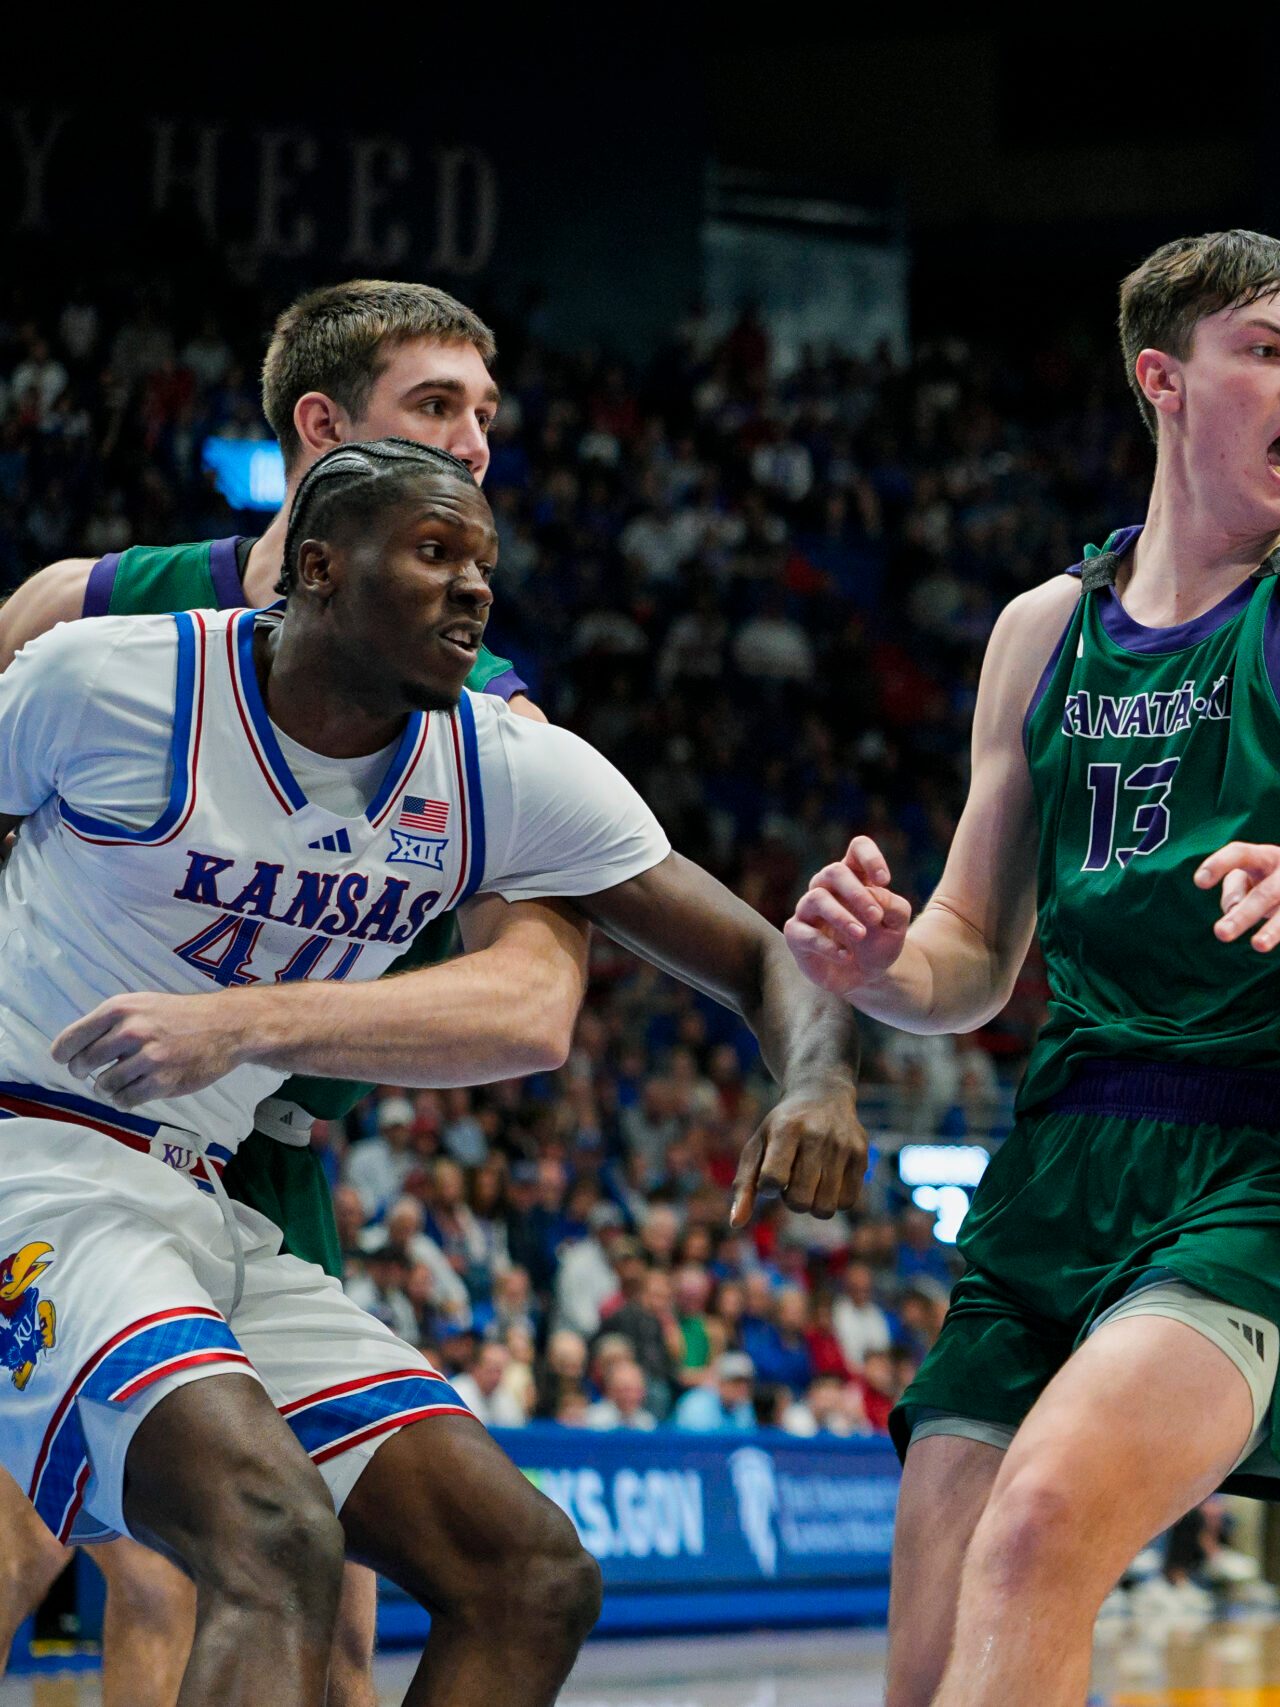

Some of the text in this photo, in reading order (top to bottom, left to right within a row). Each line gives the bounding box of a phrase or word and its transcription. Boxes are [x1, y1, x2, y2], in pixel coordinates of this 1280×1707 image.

[147, 114, 500, 277] HEED
[1080, 756, 1180, 871] 13
[173, 850, 442, 944] KANSAS
[161, 1143, 193, 1170] KU
[13, 1314, 32, 1349] KU
